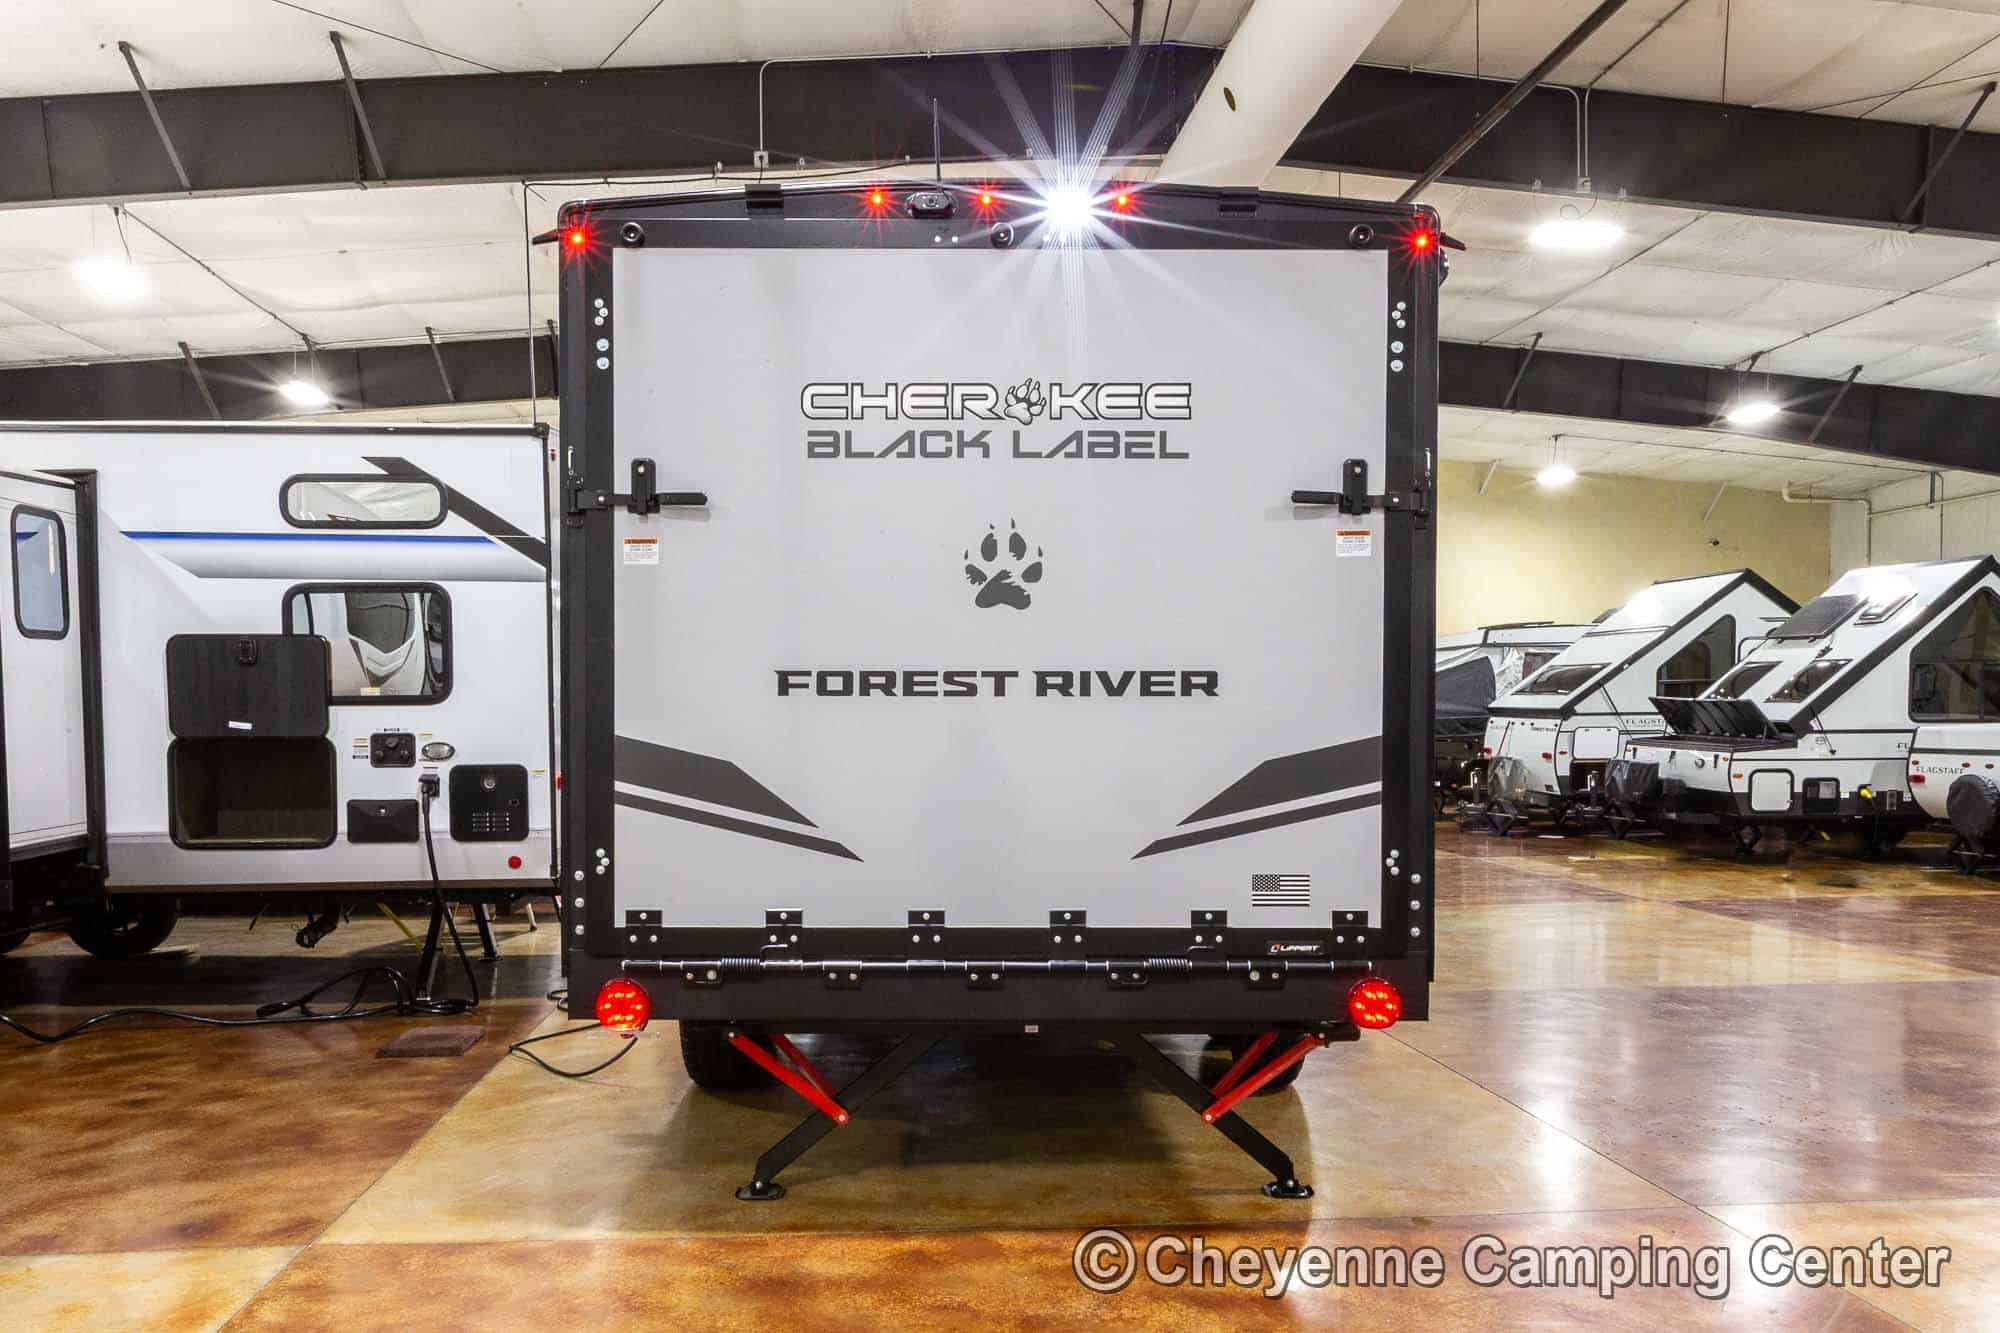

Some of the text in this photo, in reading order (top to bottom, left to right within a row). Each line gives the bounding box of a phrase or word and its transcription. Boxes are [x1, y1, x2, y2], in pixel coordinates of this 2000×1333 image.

[801, 380, 1192, 424] CHERKEE
[807, 430, 1190, 459] BLACK LABEL
[774, 670, 1219, 697] FOREST RIVER
